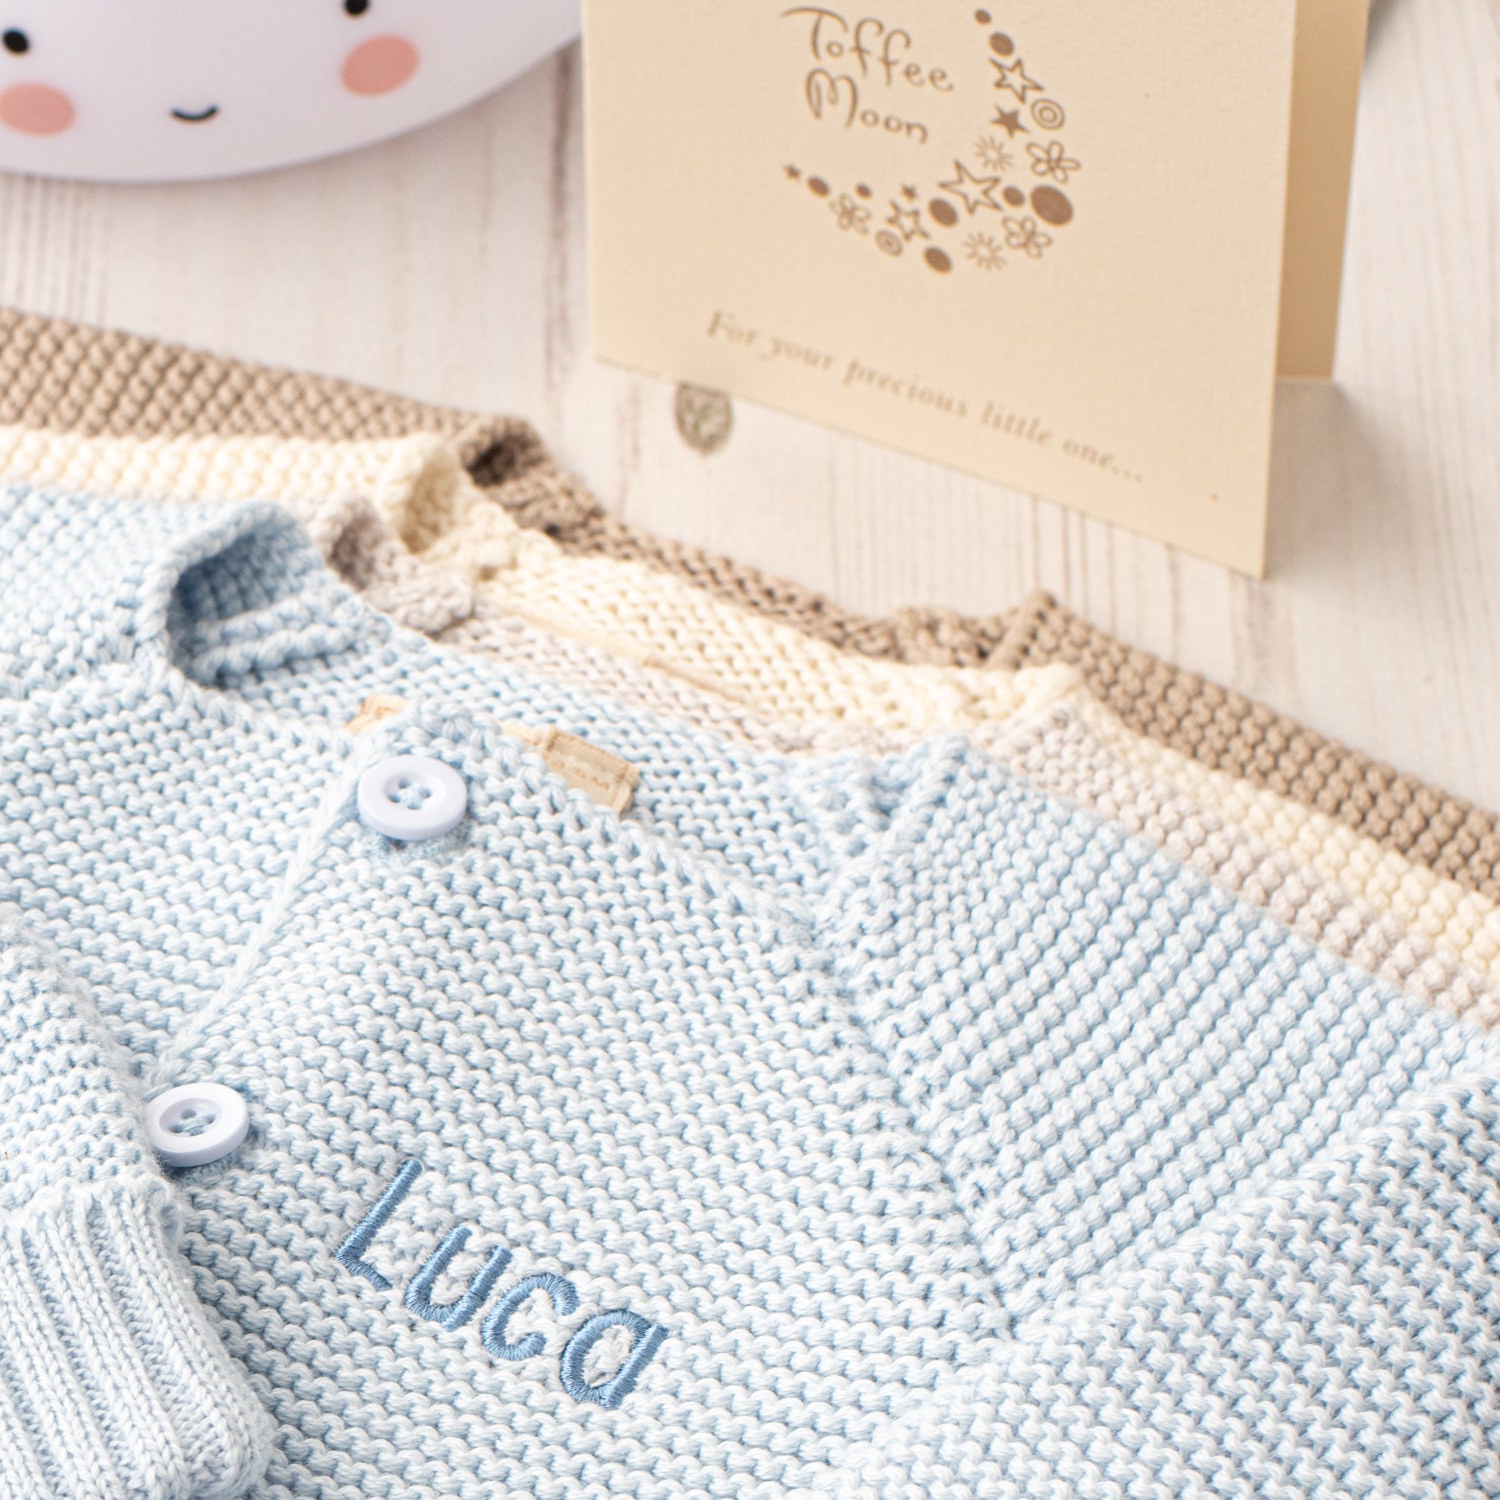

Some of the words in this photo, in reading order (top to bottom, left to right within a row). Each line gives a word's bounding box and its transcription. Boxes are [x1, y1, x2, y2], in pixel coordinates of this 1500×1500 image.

[781, 6, 955, 93] Toffee
[804, 68, 929, 145] Moon
[706, 309, 757, 347] For
[757, 335, 836, 371] your
[841, 358, 968, 420] precious
[979, 400, 1053, 446] little
[336, 1158, 669, 1410] Luca
